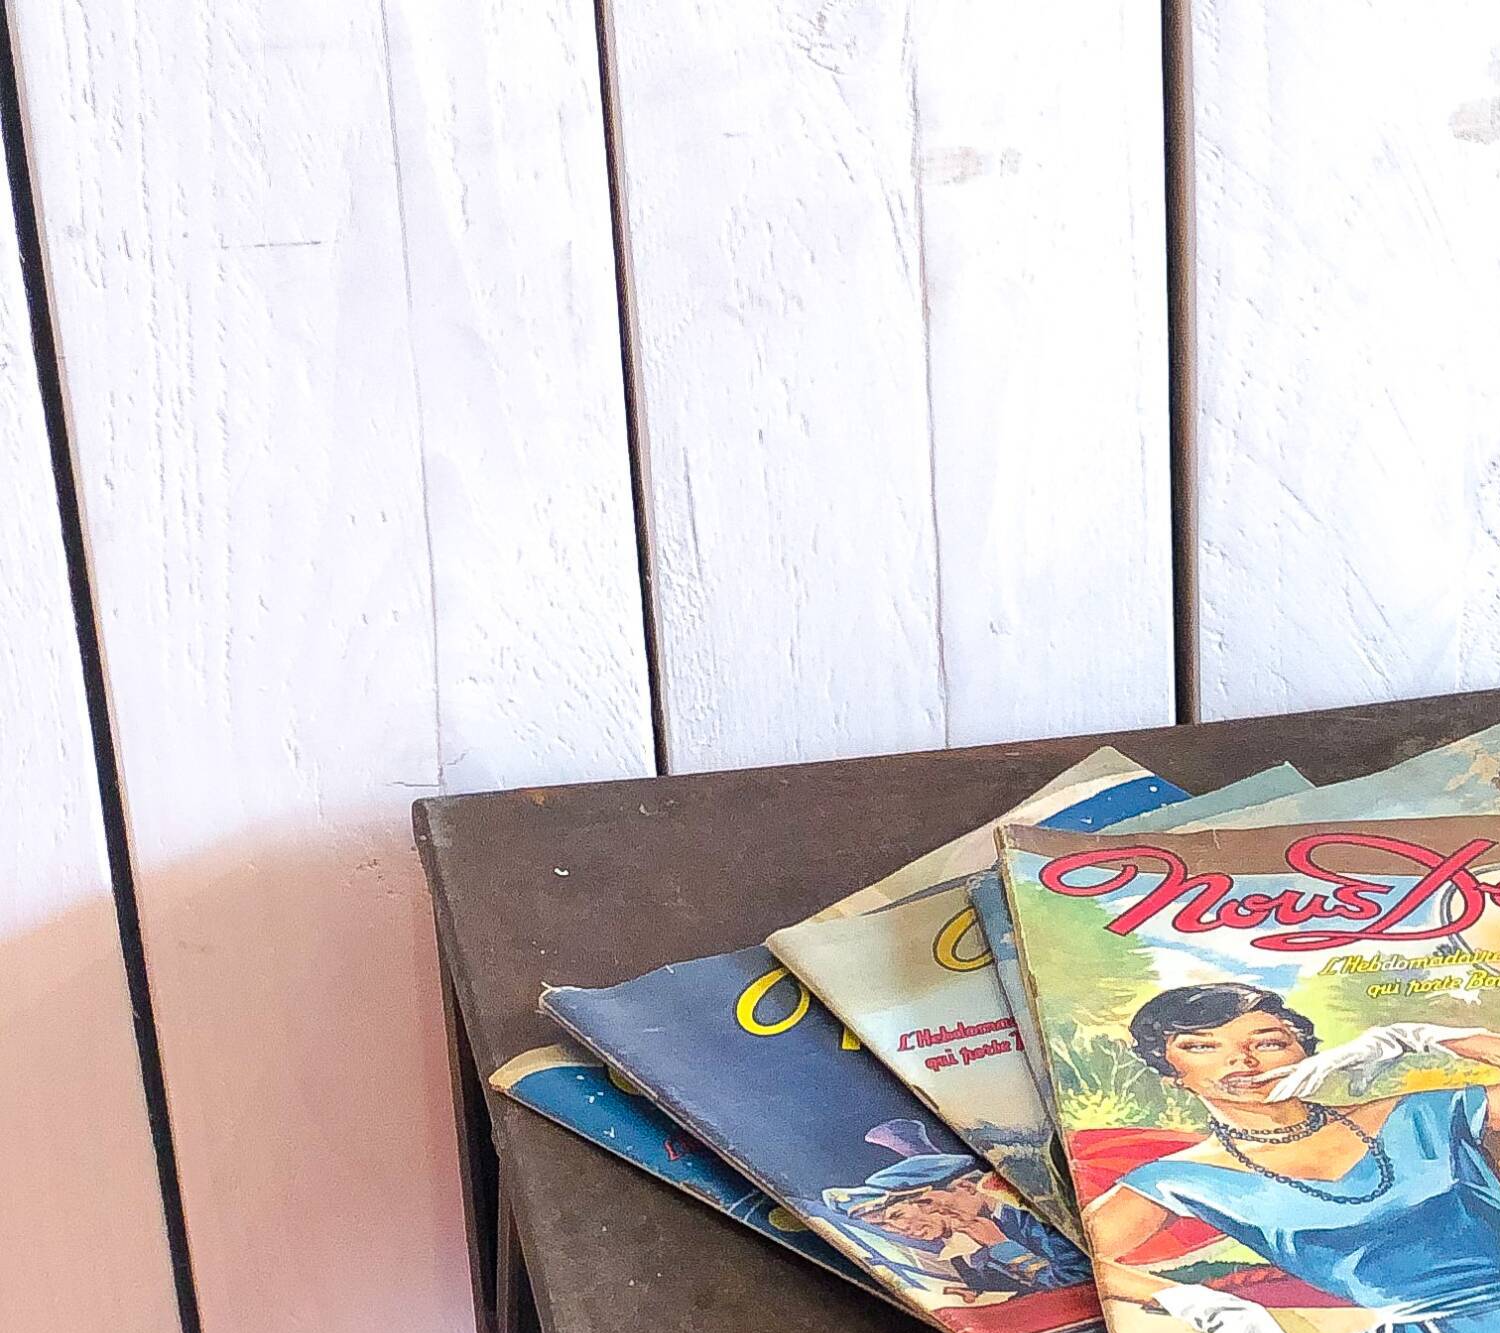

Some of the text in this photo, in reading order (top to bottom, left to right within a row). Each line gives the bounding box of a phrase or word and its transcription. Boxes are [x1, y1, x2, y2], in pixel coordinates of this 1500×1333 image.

[1038, 846, 1384, 936] Nous
[1367, 980, 1400, 999] qui
[1406, 976, 1461, 996] porte
